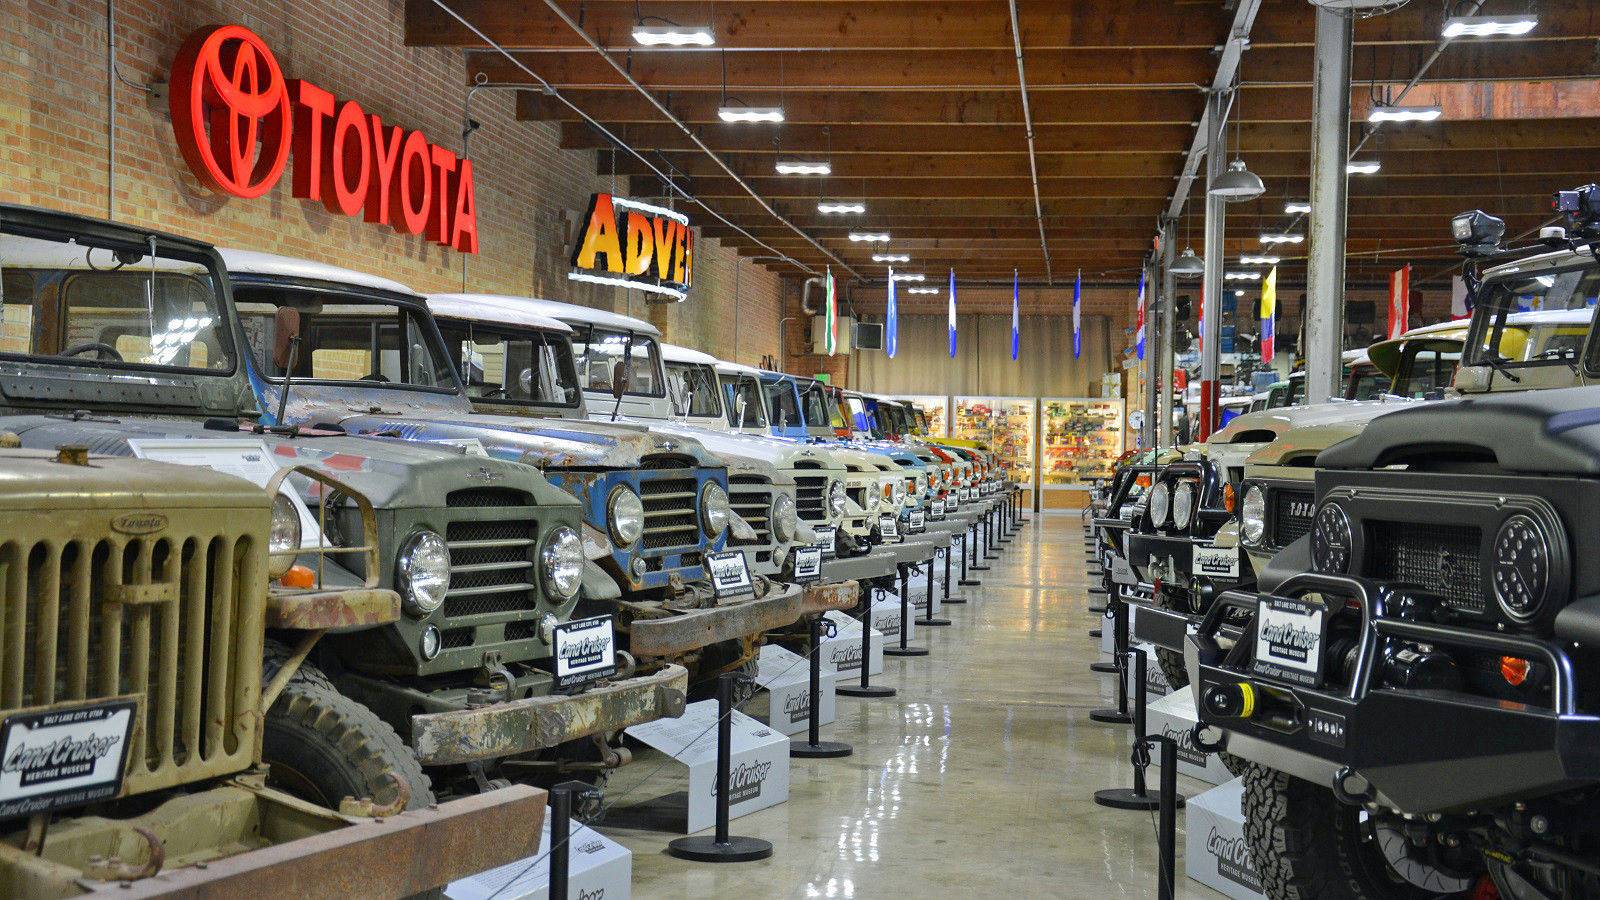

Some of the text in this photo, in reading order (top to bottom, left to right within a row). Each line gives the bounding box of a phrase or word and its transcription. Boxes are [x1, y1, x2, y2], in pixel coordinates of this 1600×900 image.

[296, 79, 478, 255] TOYOTA
[1290, 502, 1316, 518] TOYO
[121, 517, 161, 529] Toyota
[1260, 618, 1320, 651] Land Cruiser
[559, 636, 611, 660] Land Cruiser
[1271, 645, 1306, 659] HERITAGE MUSEUM
[2, 732, 120, 774] Land Cruiser
[25, 763, 91, 781] HERITAGE MUSEUM
[736, 760, 771, 788] Cruiser
[20, 796, 53, 812] Cruiser
[55, 793, 86, 804] HERITAGE
[87, 787, 114, 799] MUSEUM
[742, 786, 759, 796] MUSEUM
[1206, 825, 1236, 860] Land
[1220, 862, 1241, 878] HERITAGE
